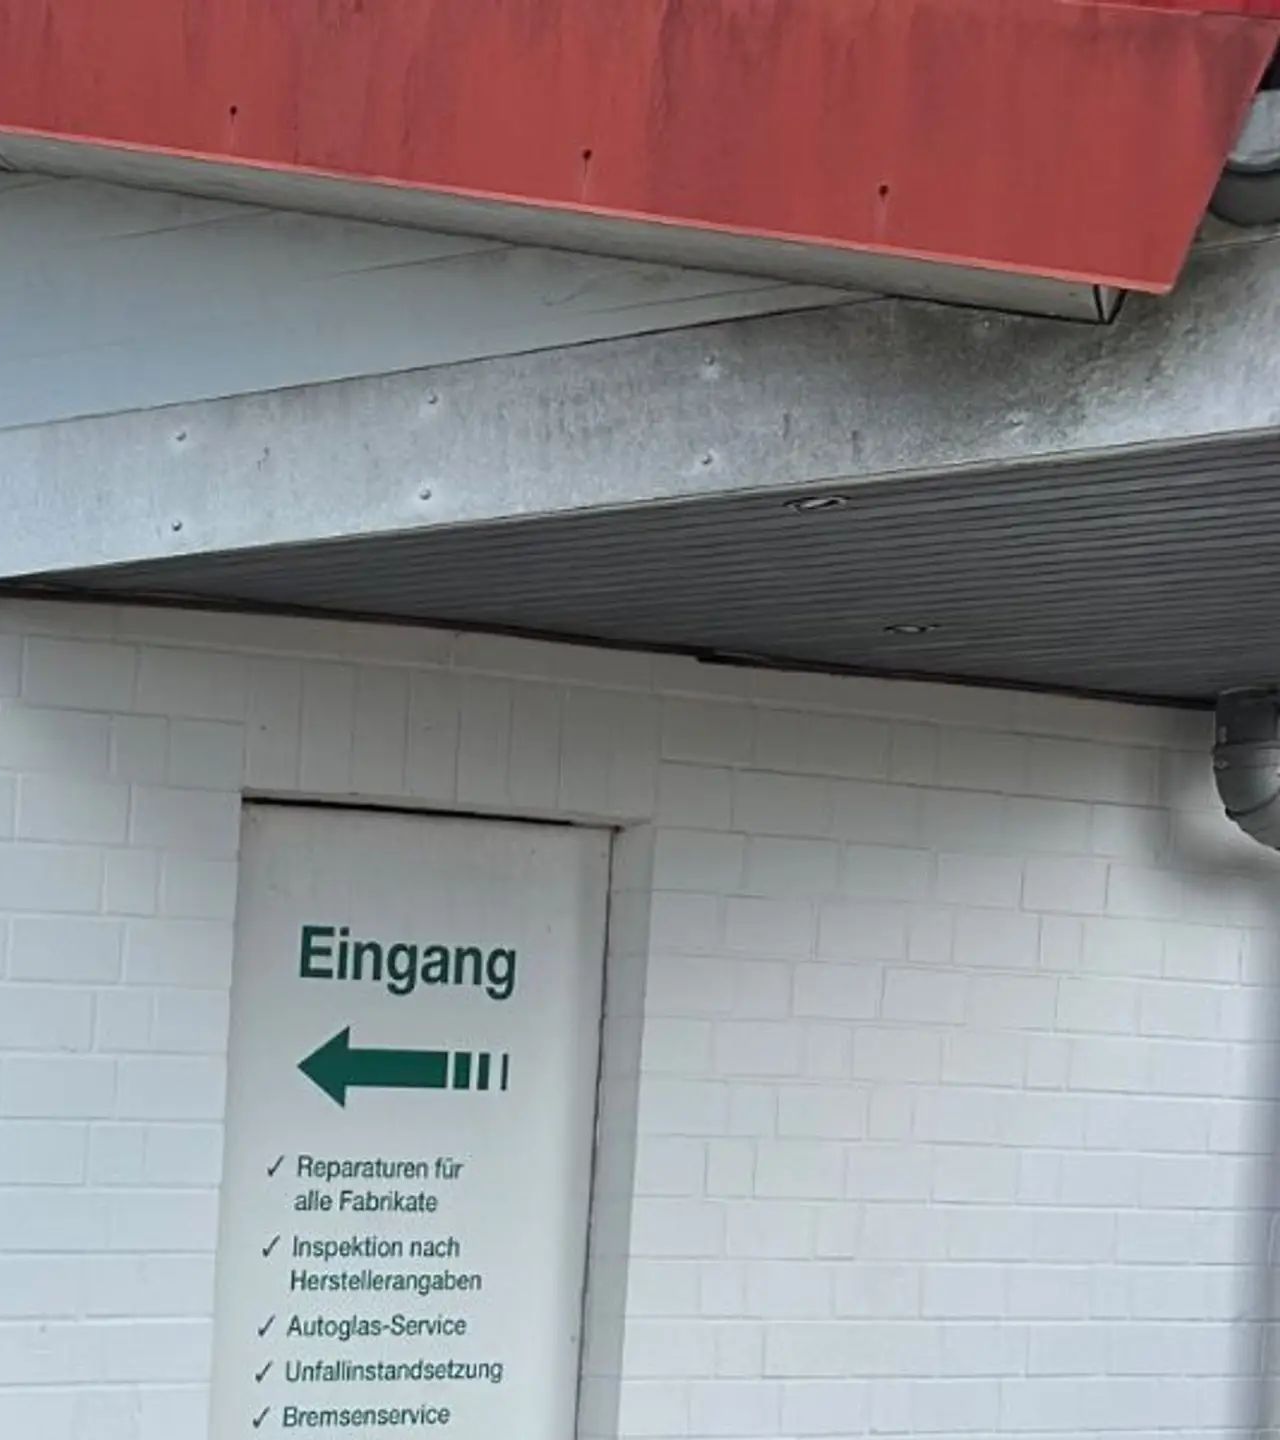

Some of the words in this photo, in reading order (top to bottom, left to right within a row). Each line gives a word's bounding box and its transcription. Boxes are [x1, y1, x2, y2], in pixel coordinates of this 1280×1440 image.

[299, 925, 517, 1001] Eingang
[297, 1154, 429, 1183] Reparaturen
[434, 1156, 465, 1180] für
[294, 1189, 333, 1212] alle
[339, 1189, 439, 1213] Fabrikate
[292, 1235, 403, 1262] Inspektion
[409, 1235, 461, 1258] nach
[290, 1269, 482, 1297] Herstellerangaben
[286, 1313, 467, 1342] Autoglas-Service
[285, 1359, 504, 1384] Unfallinstandsetzung
[282, 1404, 451, 1428] Bremsenservice
